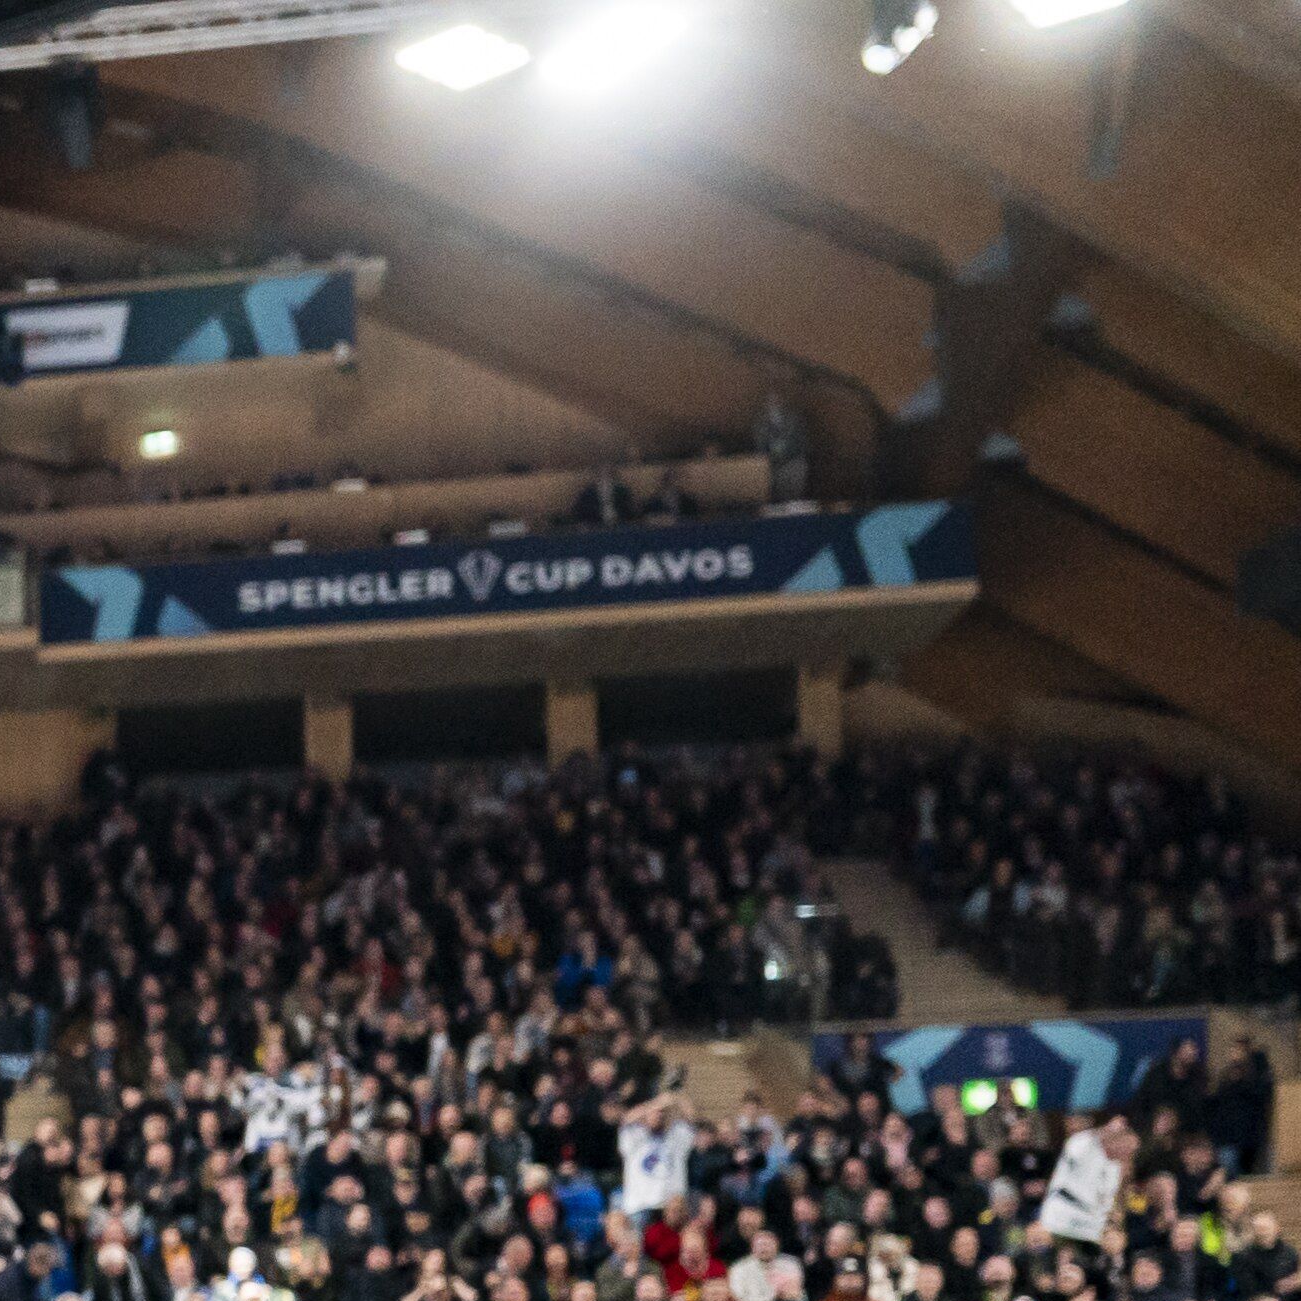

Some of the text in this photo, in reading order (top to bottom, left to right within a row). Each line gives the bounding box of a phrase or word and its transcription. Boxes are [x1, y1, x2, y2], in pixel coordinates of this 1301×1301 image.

[238, 545, 754, 613] SPENGLER CUP DAVOS
